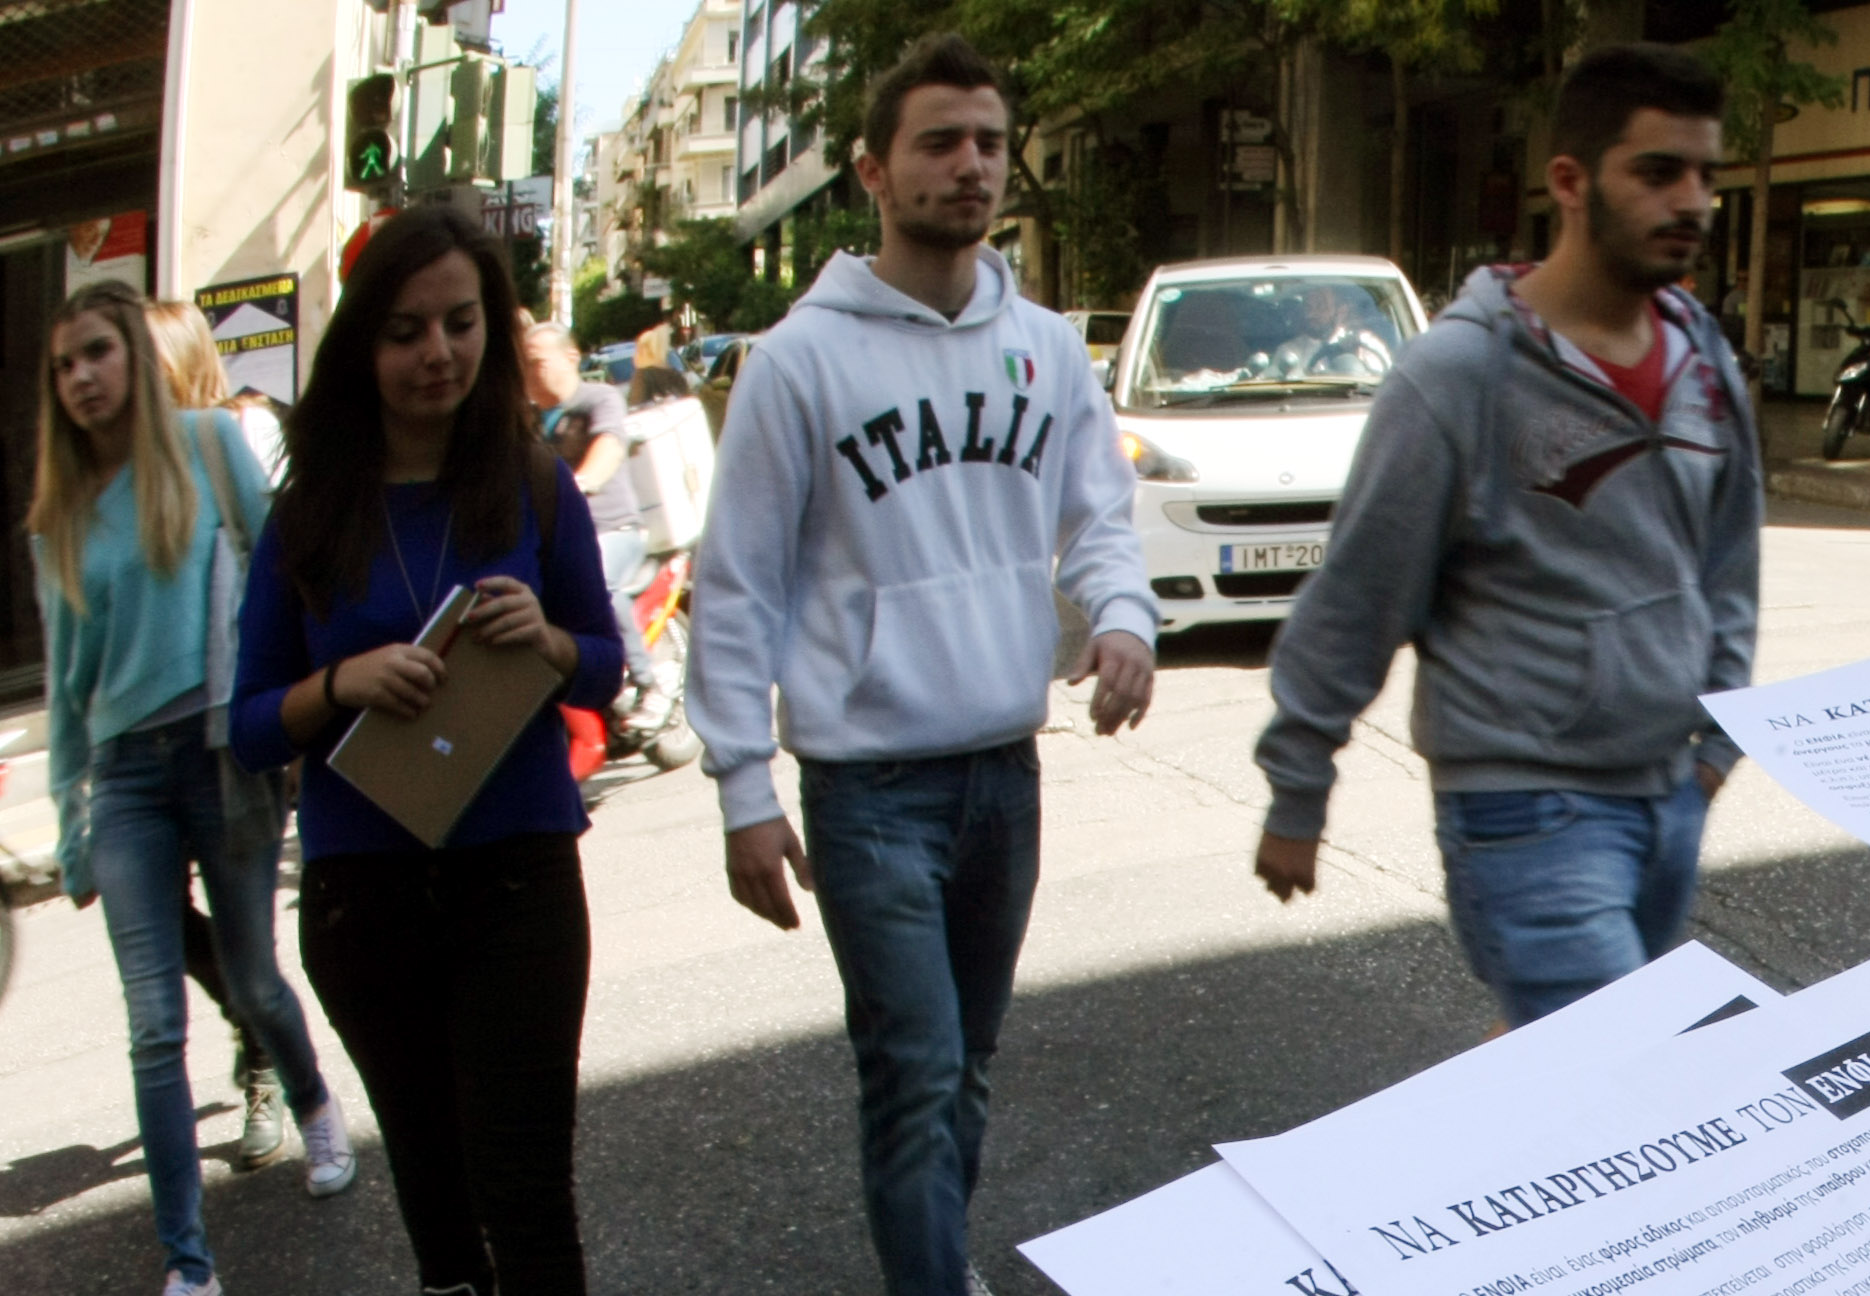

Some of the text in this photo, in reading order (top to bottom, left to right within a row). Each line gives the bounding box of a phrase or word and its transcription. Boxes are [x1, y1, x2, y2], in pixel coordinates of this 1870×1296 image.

[836, 392, 1053, 502] ITALIA
[1243, 545, 1324, 569] IMT-20
[1765, 712, 1814, 731] ΝΑ
[1368, 1215, 1460, 1260] ΝΑ
[1445, 1116, 1747, 1237] ΚΑΤΑΡΓΗΣΟΥΜΕ
[1737, 1088, 1815, 1136] ΤΟΝ
[1529, 1264, 1568, 1285] είναι
[1563, 1251, 1604, 1272] ένας
[1597, 1235, 1648, 1262] φόρος
[1639, 1217, 1692, 1243] άδικος
[1684, 1209, 1709, 1225] και
[1703, 1164, 1811, 1217] αντισυνταγματικός,
[1803, 1154, 1830, 1175] που
